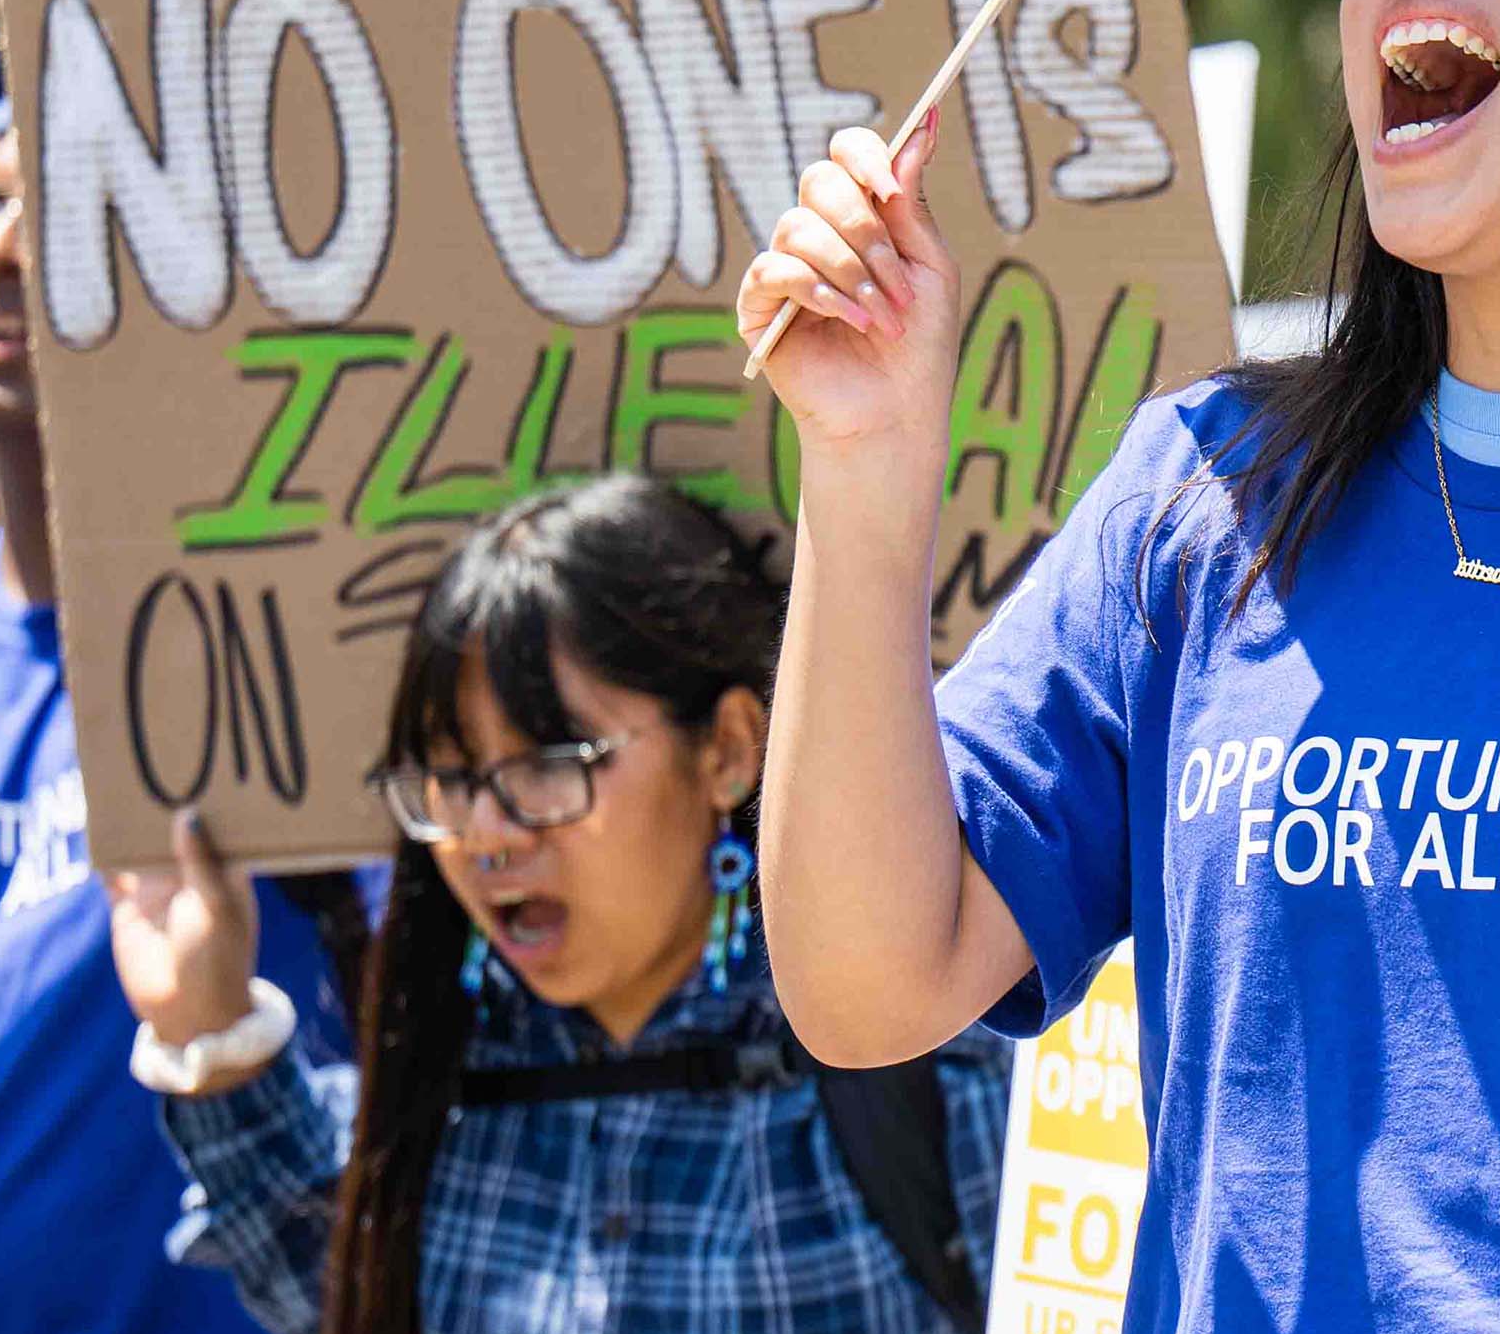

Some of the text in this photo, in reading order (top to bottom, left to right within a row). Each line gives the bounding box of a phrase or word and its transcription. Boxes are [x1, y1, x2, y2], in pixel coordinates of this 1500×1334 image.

[175, 259, 1164, 553] ILLEAL
[122, 572, 308, 810] ON
[1235, 806, 1374, 887] FOR
[1021, 1181, 1141, 1280] FO
